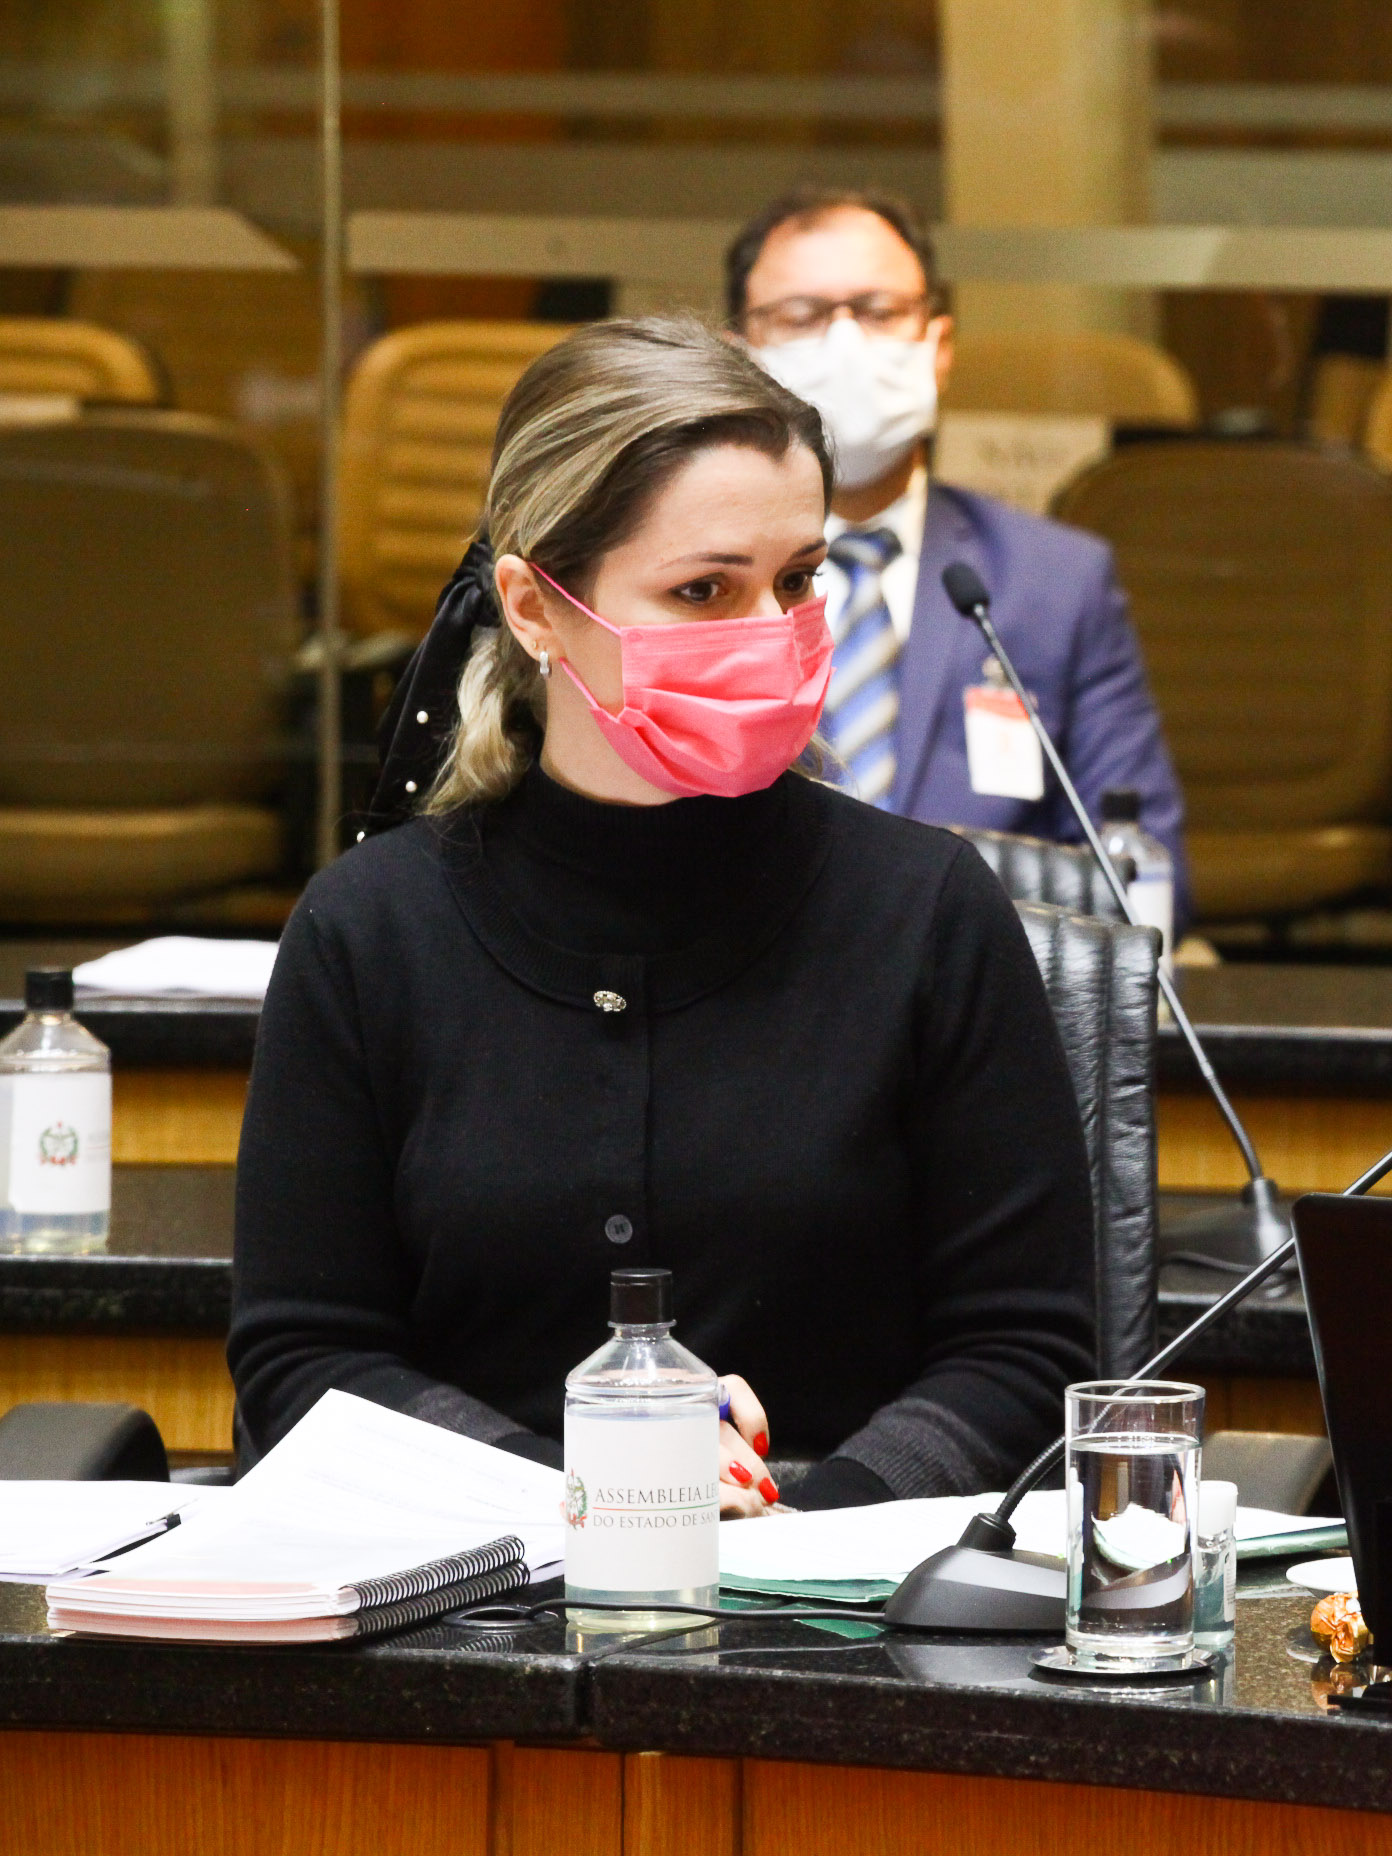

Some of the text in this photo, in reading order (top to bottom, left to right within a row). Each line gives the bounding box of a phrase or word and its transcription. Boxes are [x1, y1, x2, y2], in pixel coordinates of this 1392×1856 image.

[595, 1486, 702, 1504] ASSEMBLEIA
[593, 1514, 614, 1528] DO
[619, 1514, 677, 1529] ESTADO
[682, 1513, 698, 1527] DE
